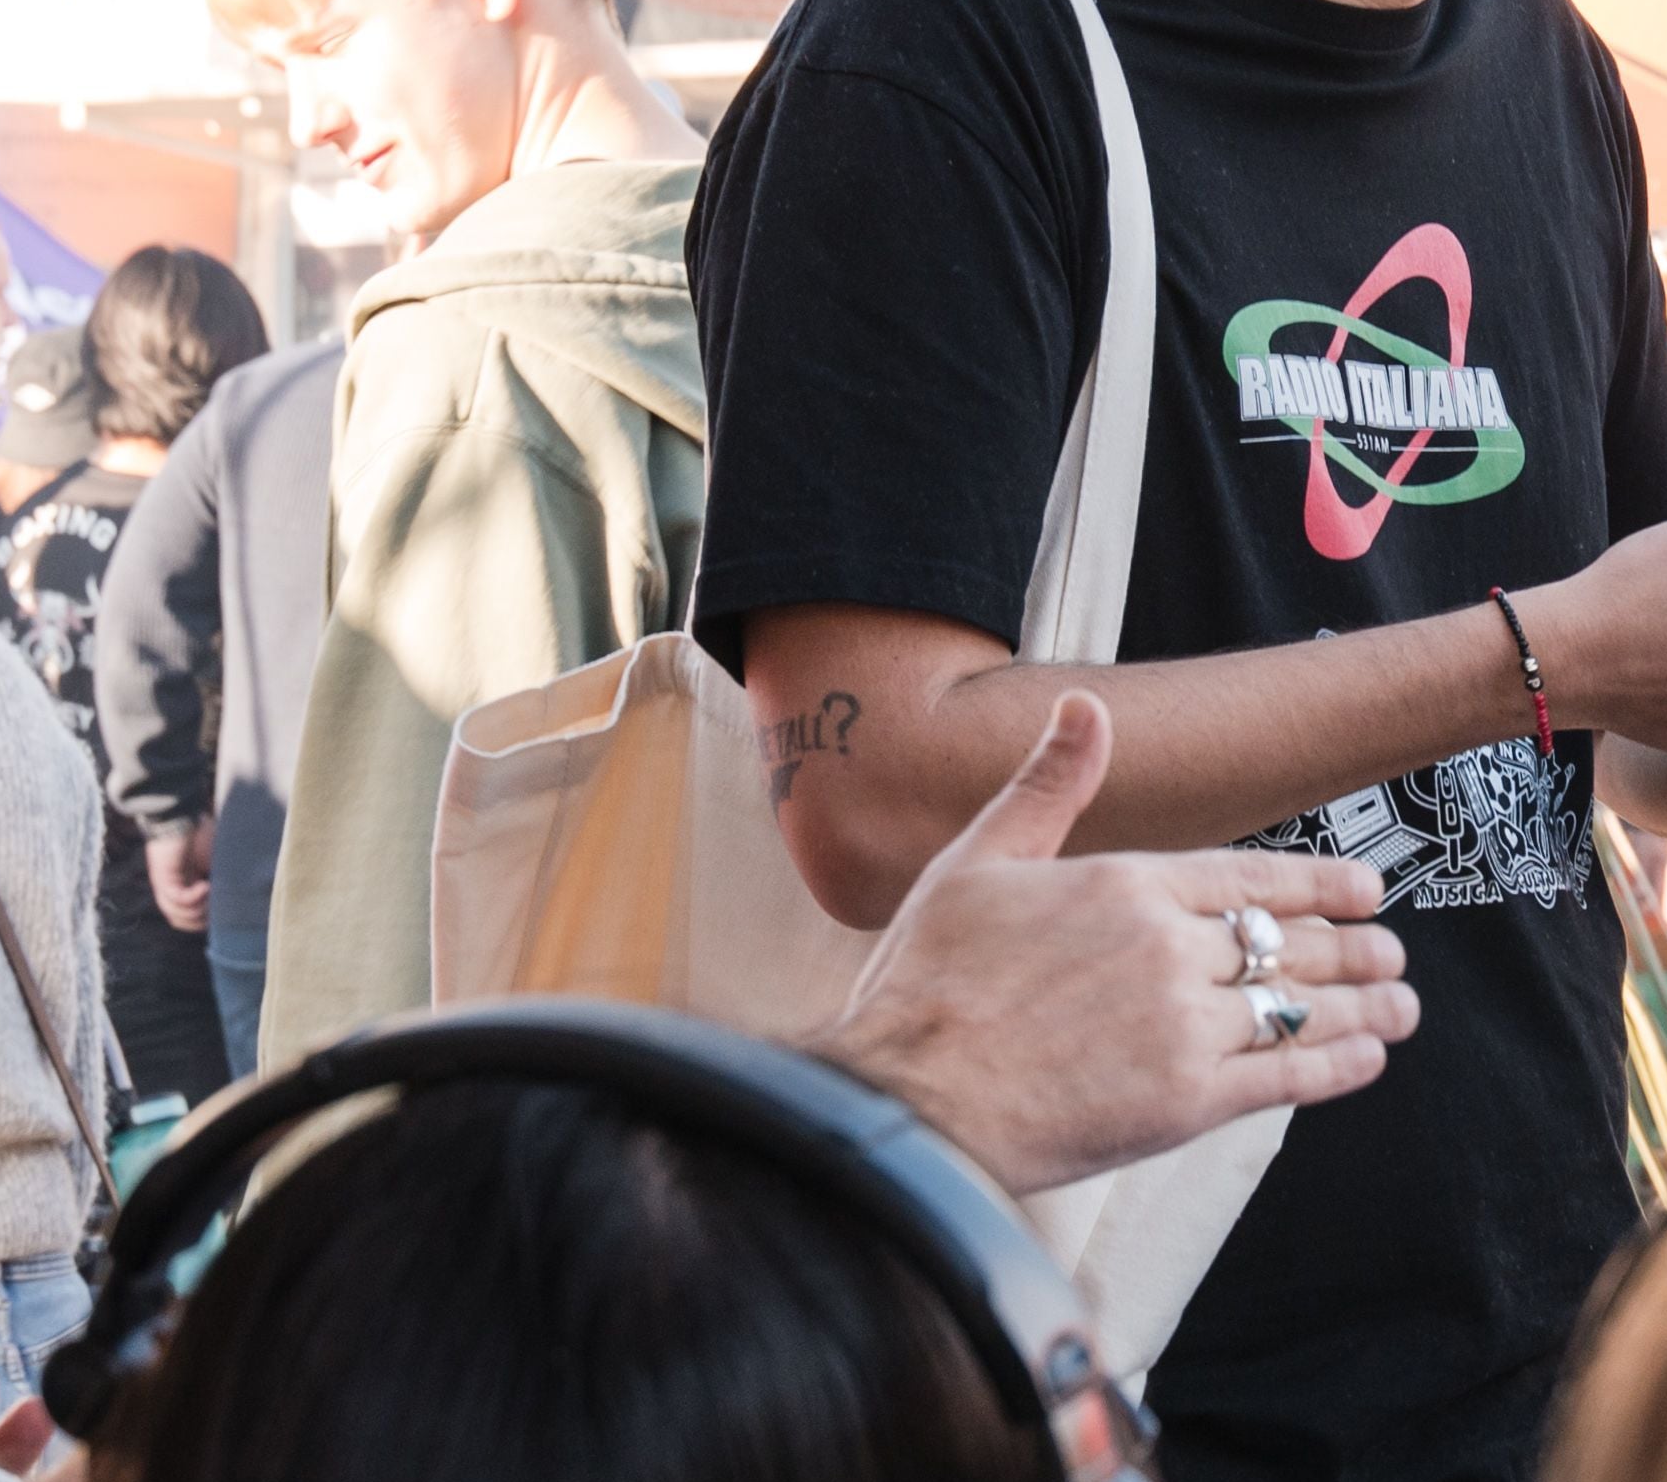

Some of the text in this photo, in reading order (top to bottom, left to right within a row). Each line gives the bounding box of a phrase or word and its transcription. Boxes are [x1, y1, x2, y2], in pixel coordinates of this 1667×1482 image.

[1236, 354, 1511, 430] RADIO ITALIANA
[1357, 433, 1390, 454] 531AM
[1499, 742, 1513, 760] IN
